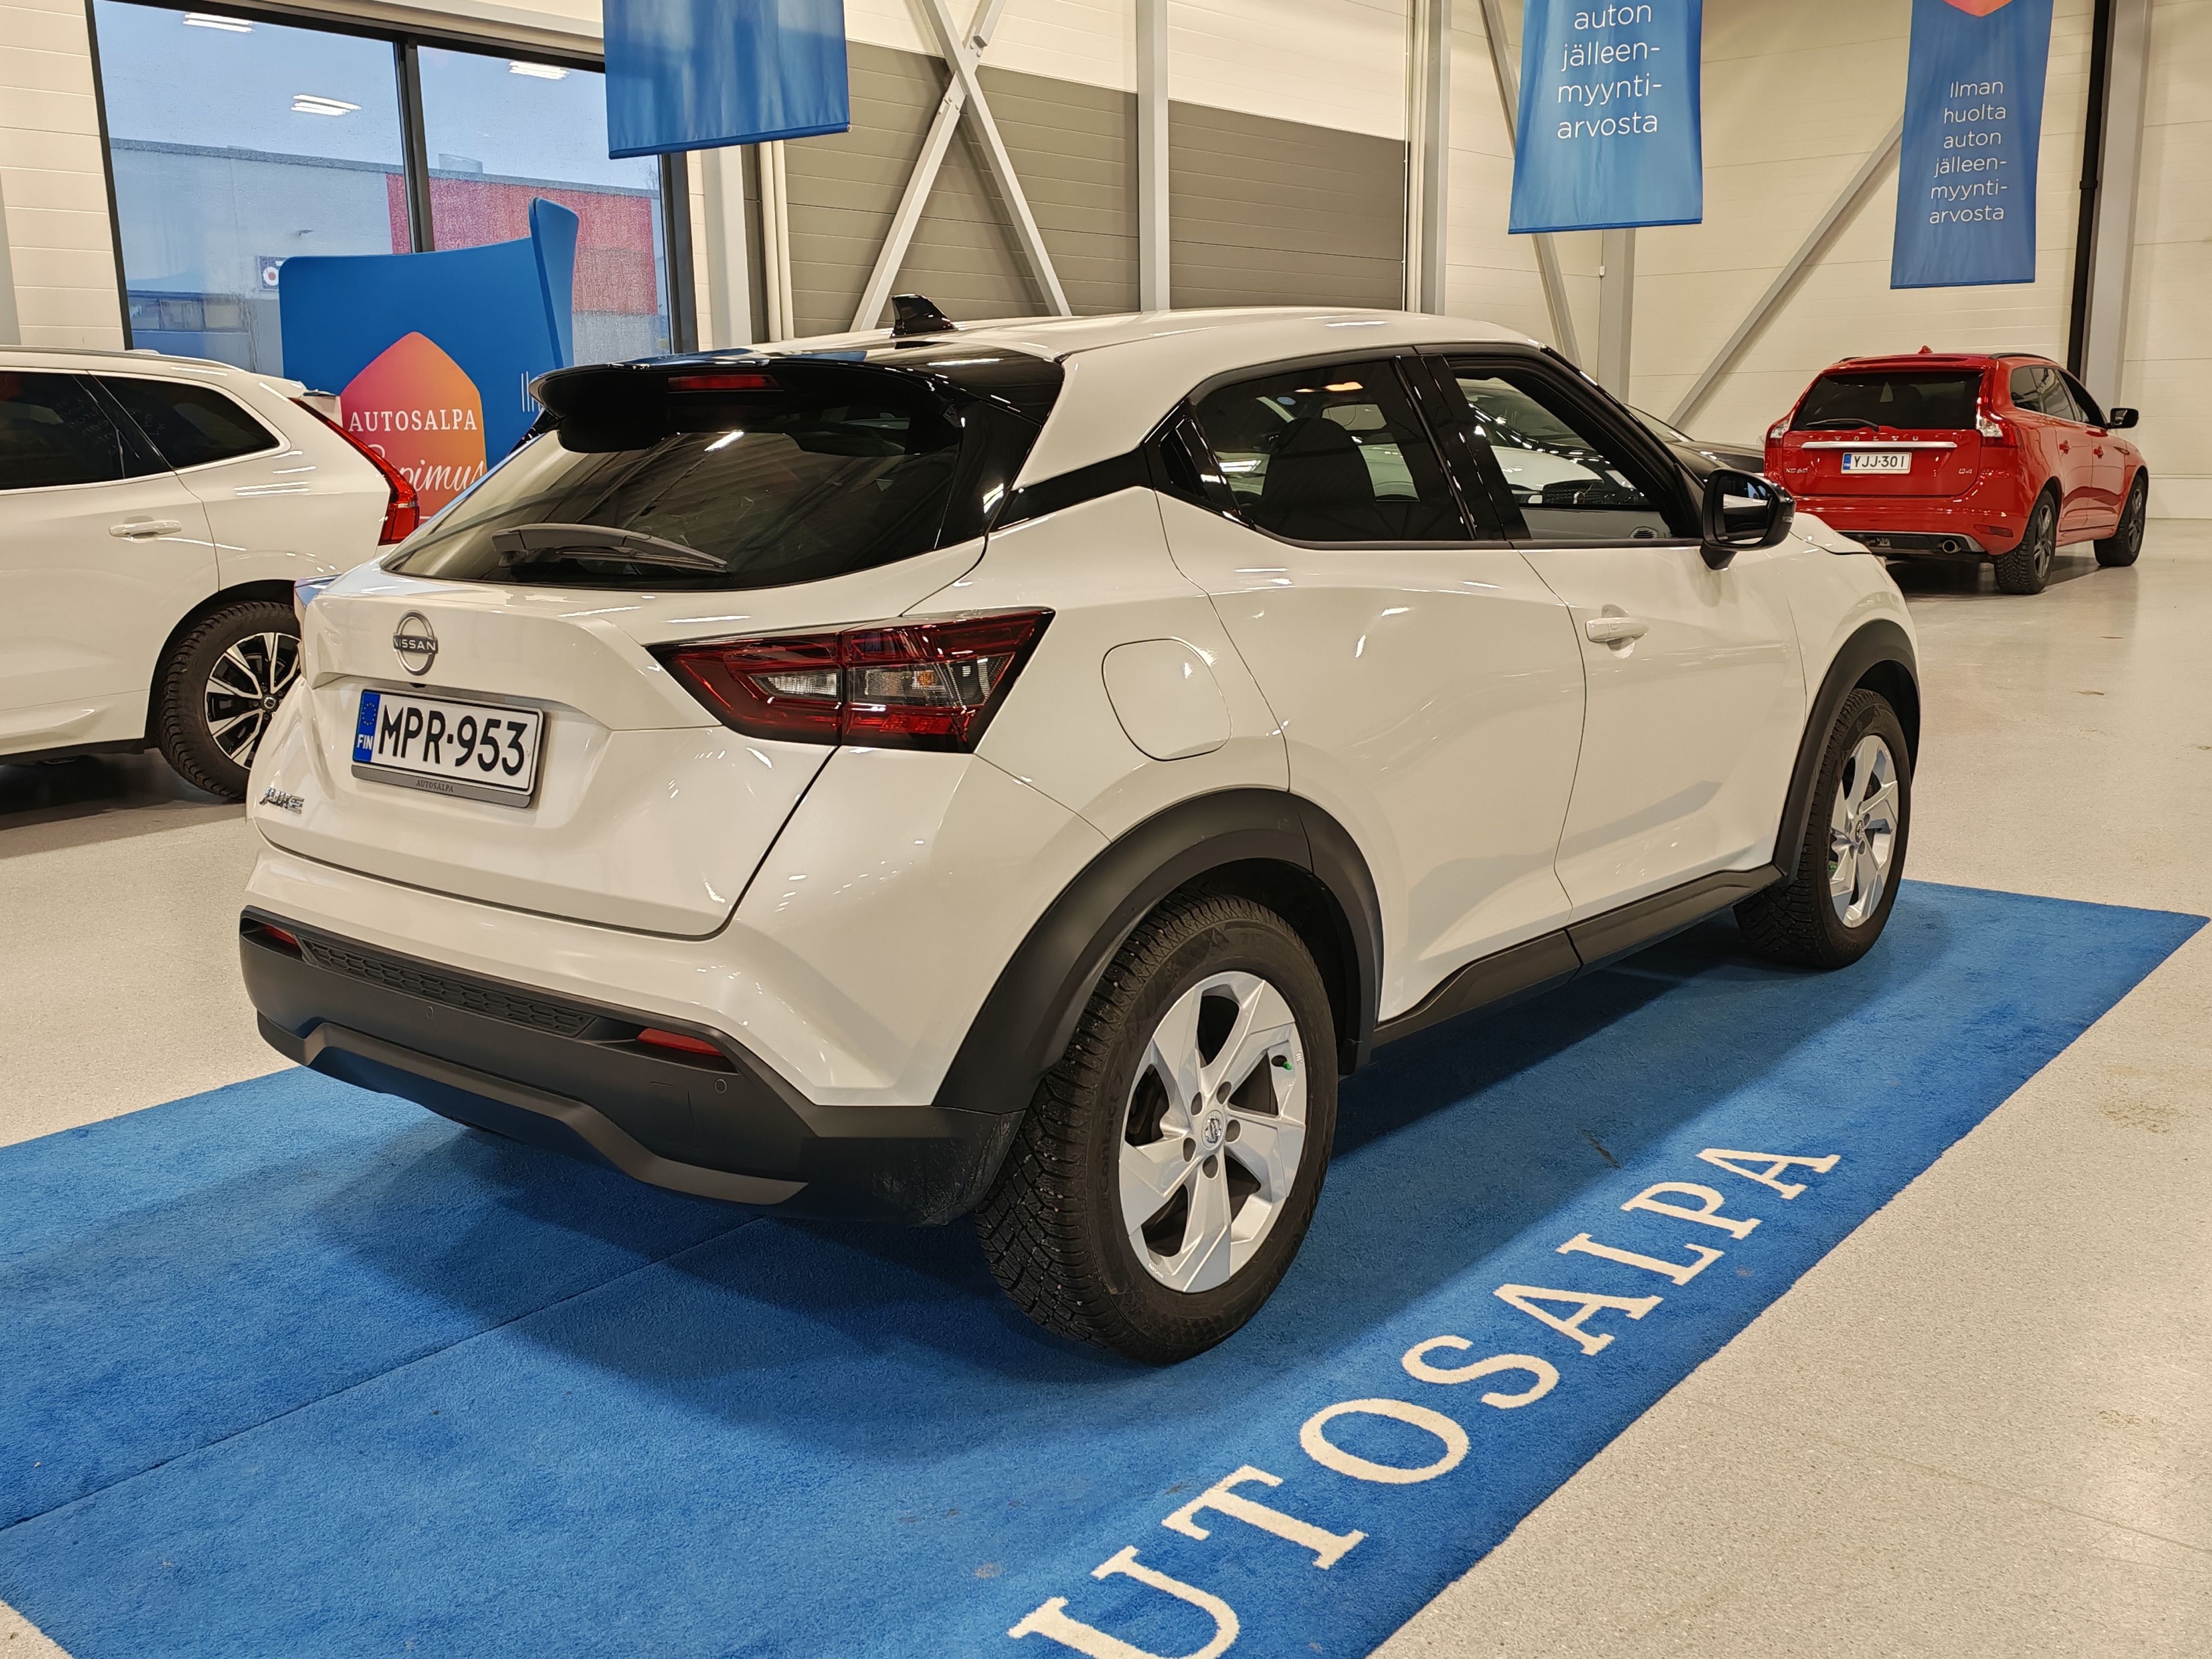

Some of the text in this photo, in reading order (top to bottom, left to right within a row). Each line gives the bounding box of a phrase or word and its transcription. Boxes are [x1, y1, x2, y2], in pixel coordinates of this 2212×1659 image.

[1574, 4, 1652, 30] auton
[1561, 41, 1661, 72] jälleen-
[1557, 72, 1663, 107] myynti-
[1950, 80, 2004, 98] Ilman
[1944, 104, 2007, 124] huolta
[1557, 111, 1658, 139] arvosta
[1943, 131, 2002, 149] auton
[1933, 157, 2008, 178] jälleen-
[1931, 178, 2008, 201] myynti-
[1929, 205, 2005, 225] arvosta
[348, 409, 477, 432] AUTOSALPA
[394, 637, 436, 652] NISSAN
[356, 733, 374, 751] FIN
[415, 779, 454, 793] AUTOSALPA
